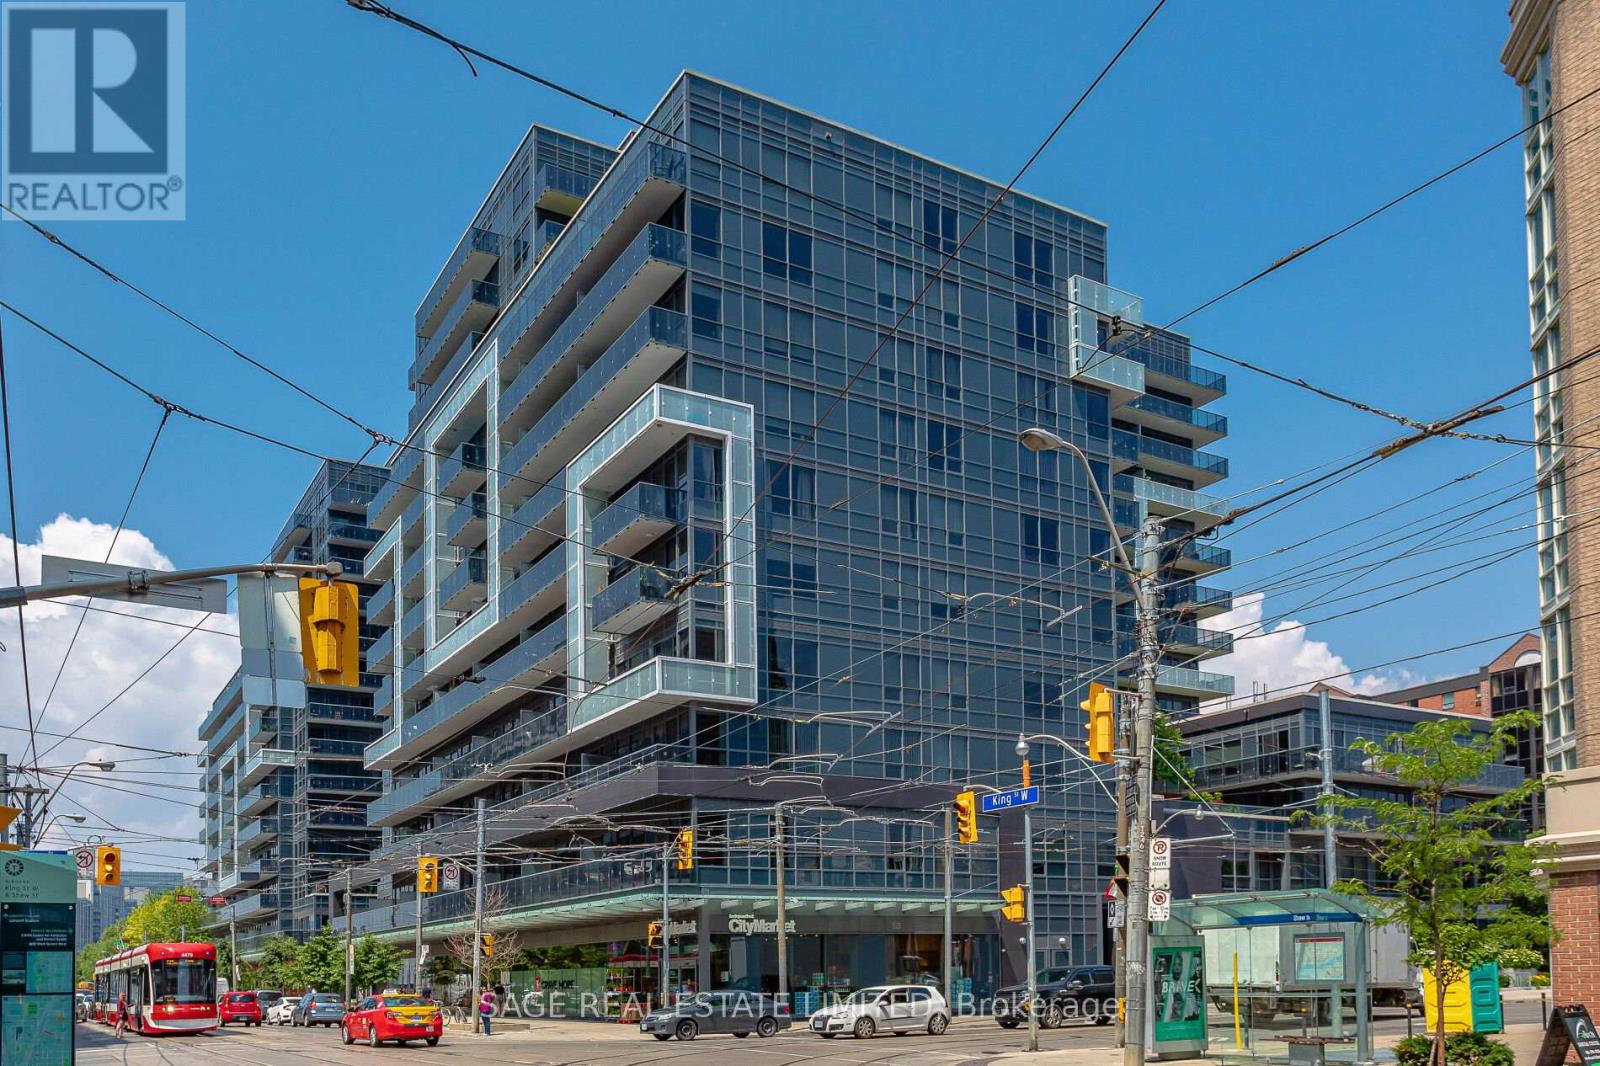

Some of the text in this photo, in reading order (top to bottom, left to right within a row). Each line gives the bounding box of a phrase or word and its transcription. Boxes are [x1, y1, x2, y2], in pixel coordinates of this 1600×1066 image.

[992, 795, 1012, 806] King
[1020, 789, 1029, 801] W
[728, 919, 796, 936] CityMaret
